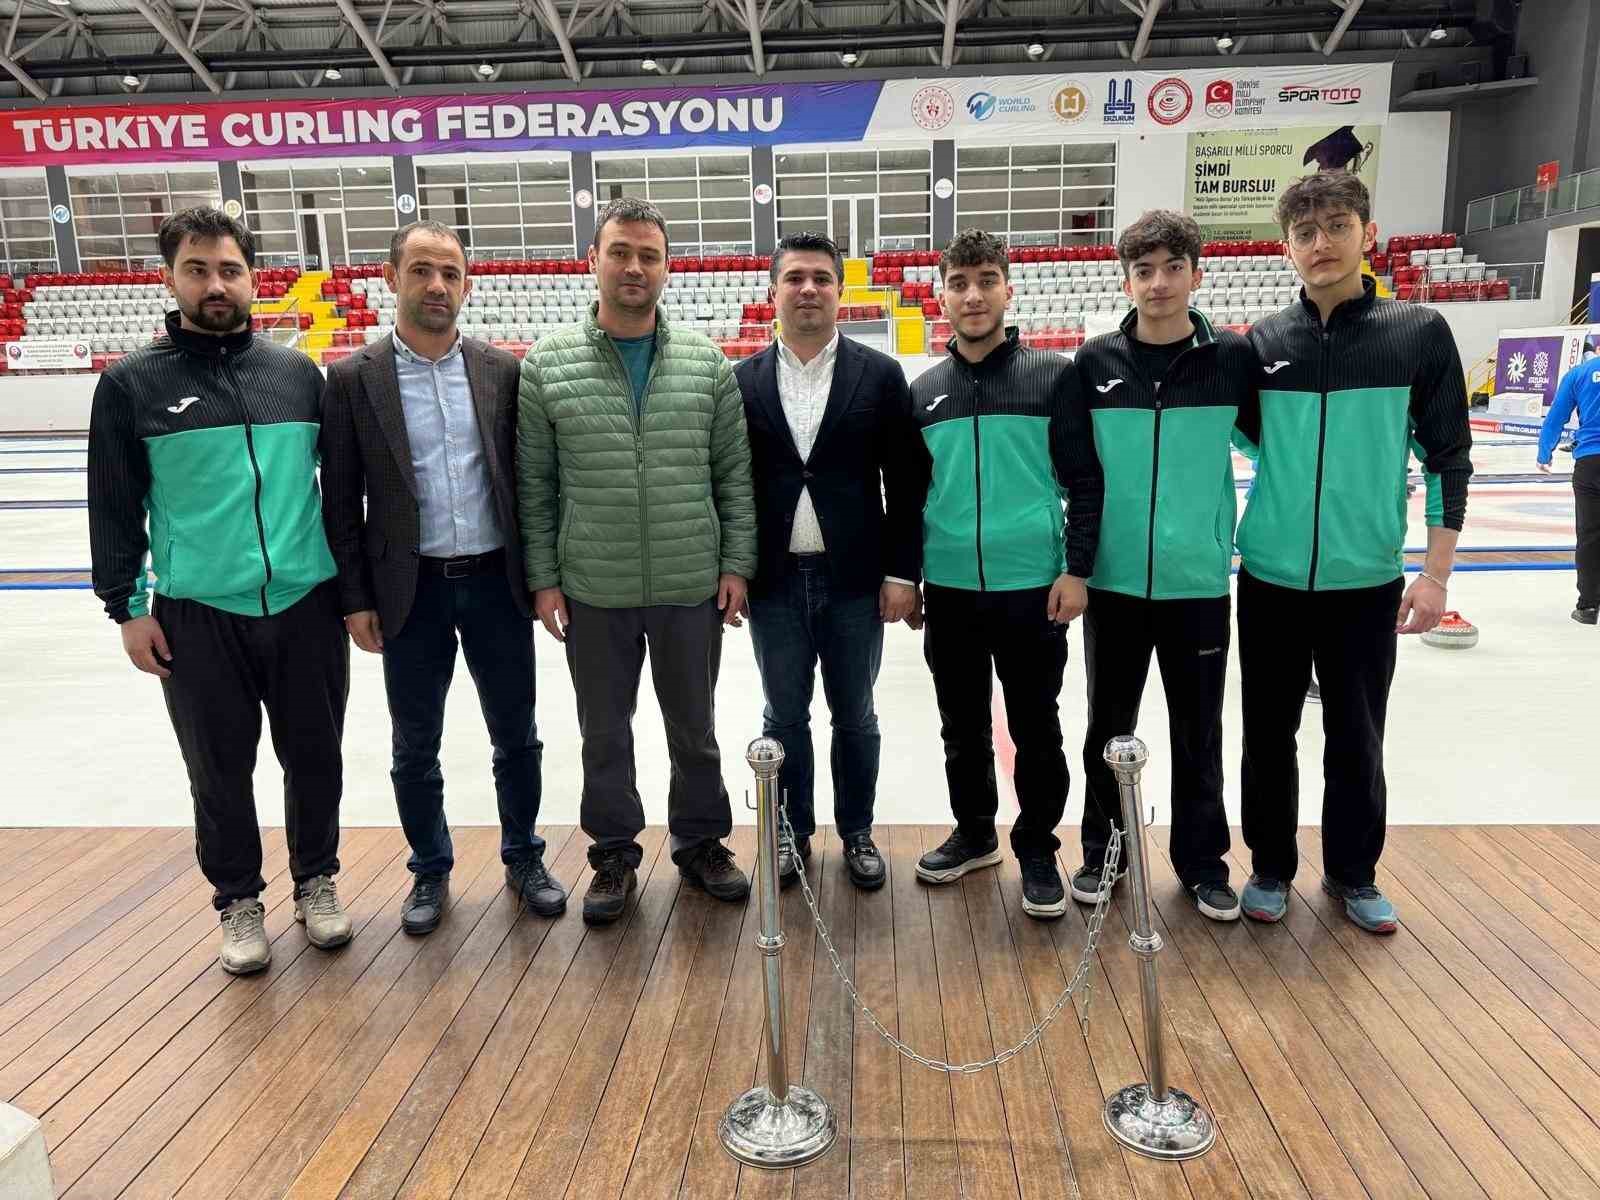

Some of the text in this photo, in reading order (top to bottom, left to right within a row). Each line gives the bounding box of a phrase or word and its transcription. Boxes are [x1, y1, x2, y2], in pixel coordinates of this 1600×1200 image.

[999, 97, 1030, 106] WORLD
[13, 97, 783, 152] TÜRKİYE CURLING FEDERASYONU
[1195, 145, 1233, 158] BAŞARILI
[1259, 143, 1293, 156] SPORCU
[1194, 160, 1231, 180] ŞİMDİ
[1194, 179, 1275, 193] TAM BURSLU!
